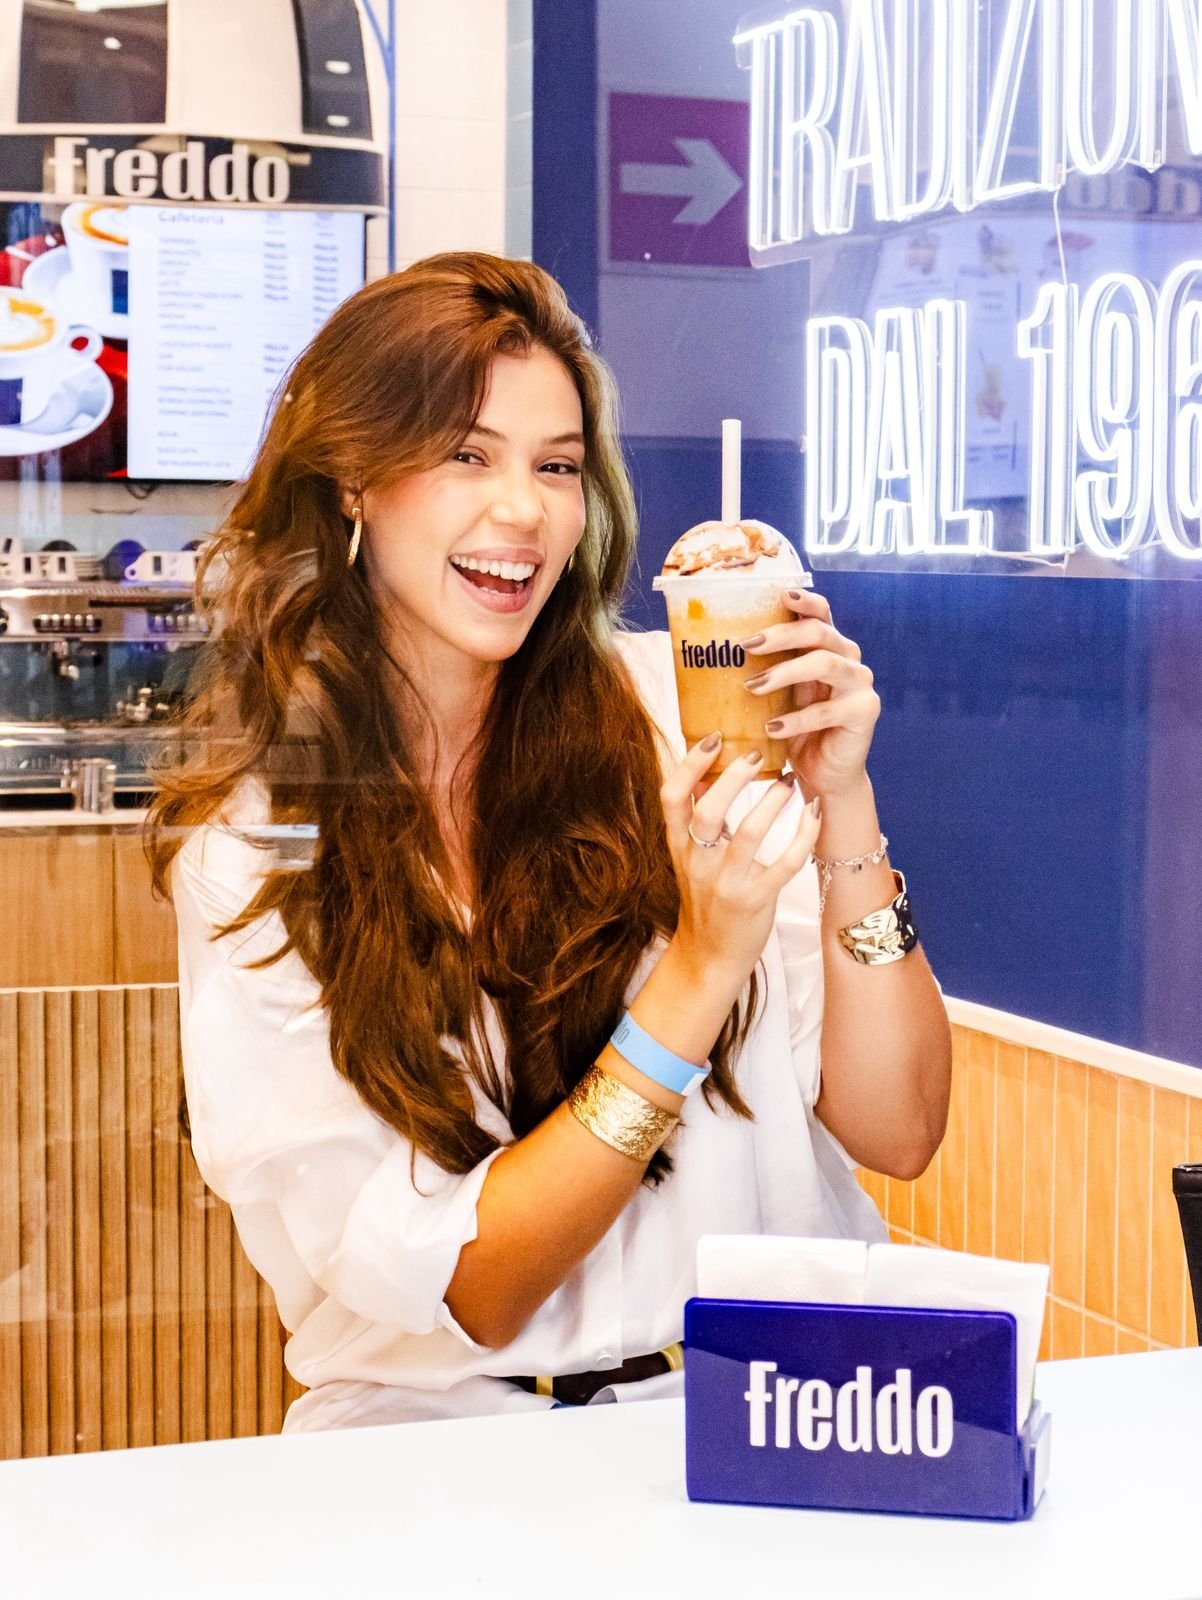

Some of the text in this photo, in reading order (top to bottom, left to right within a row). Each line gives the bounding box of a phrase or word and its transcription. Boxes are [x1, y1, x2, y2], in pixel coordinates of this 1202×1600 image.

[48, 136, 290, 203] freddo
[806, 299, 994, 555] DAL
[681, 639, 745, 668] freddo
[745, 1361, 954, 1458] freddo
